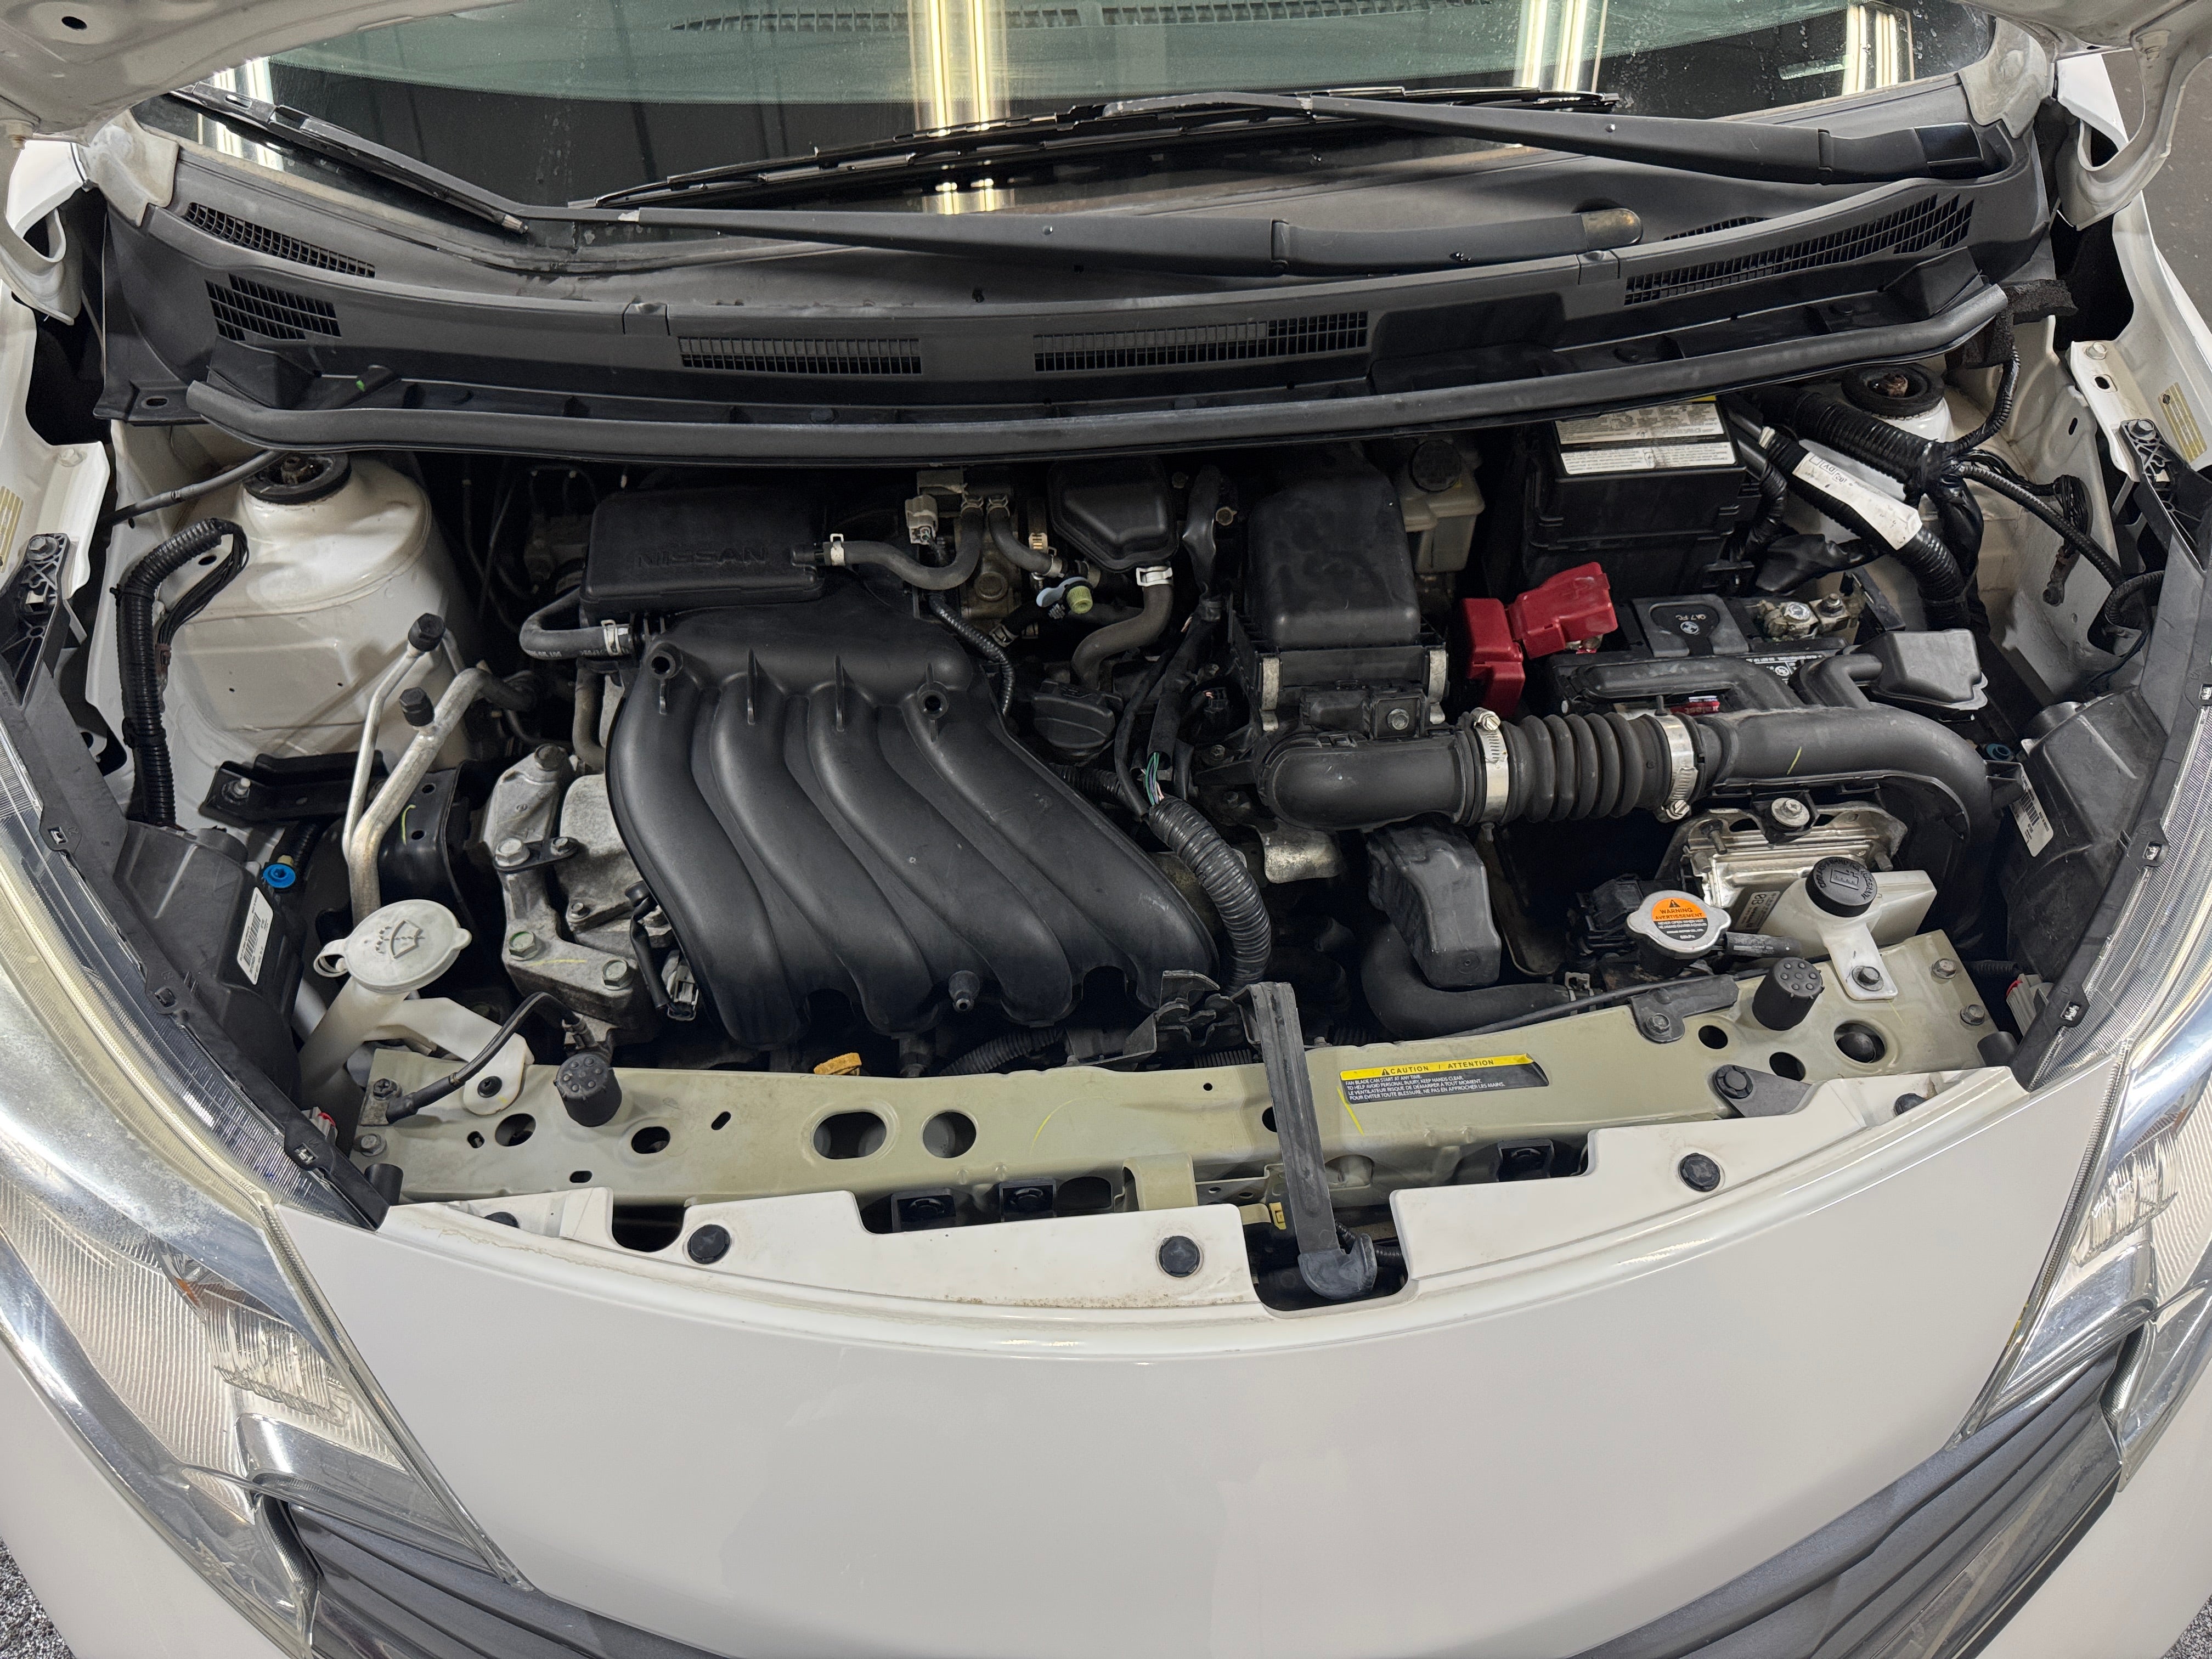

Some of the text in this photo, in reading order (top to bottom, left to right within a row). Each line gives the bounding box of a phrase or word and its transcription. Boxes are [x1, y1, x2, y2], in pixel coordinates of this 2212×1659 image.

[636, 545, 766, 567] NISSAN
[1390, 1065, 1429, 1074] CAUTION
[1448, 1059, 1494, 1069] ATTENTION
